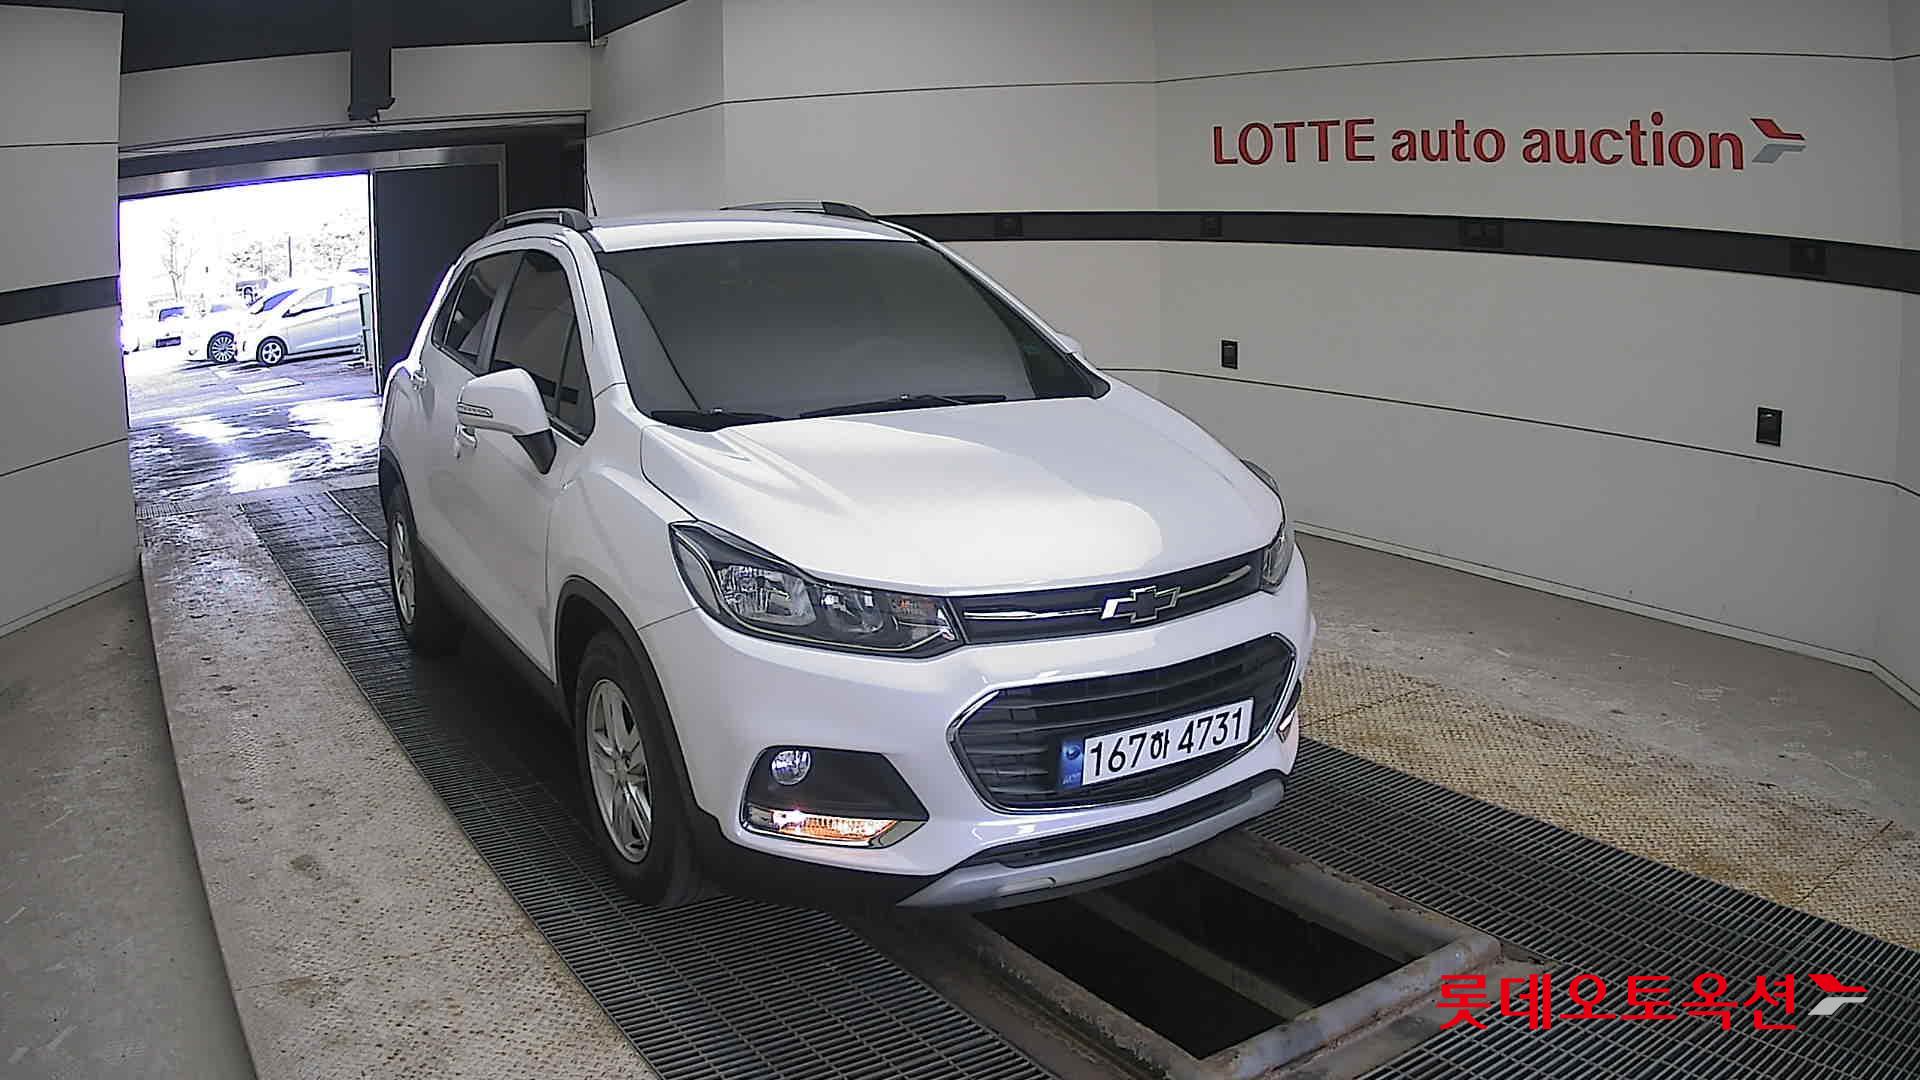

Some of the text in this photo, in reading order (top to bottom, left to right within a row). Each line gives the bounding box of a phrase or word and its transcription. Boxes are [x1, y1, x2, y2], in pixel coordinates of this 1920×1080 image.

[1212, 111, 1745, 171] LOTTE auto auction
[1089, 706, 1243, 778] 167하 4731
